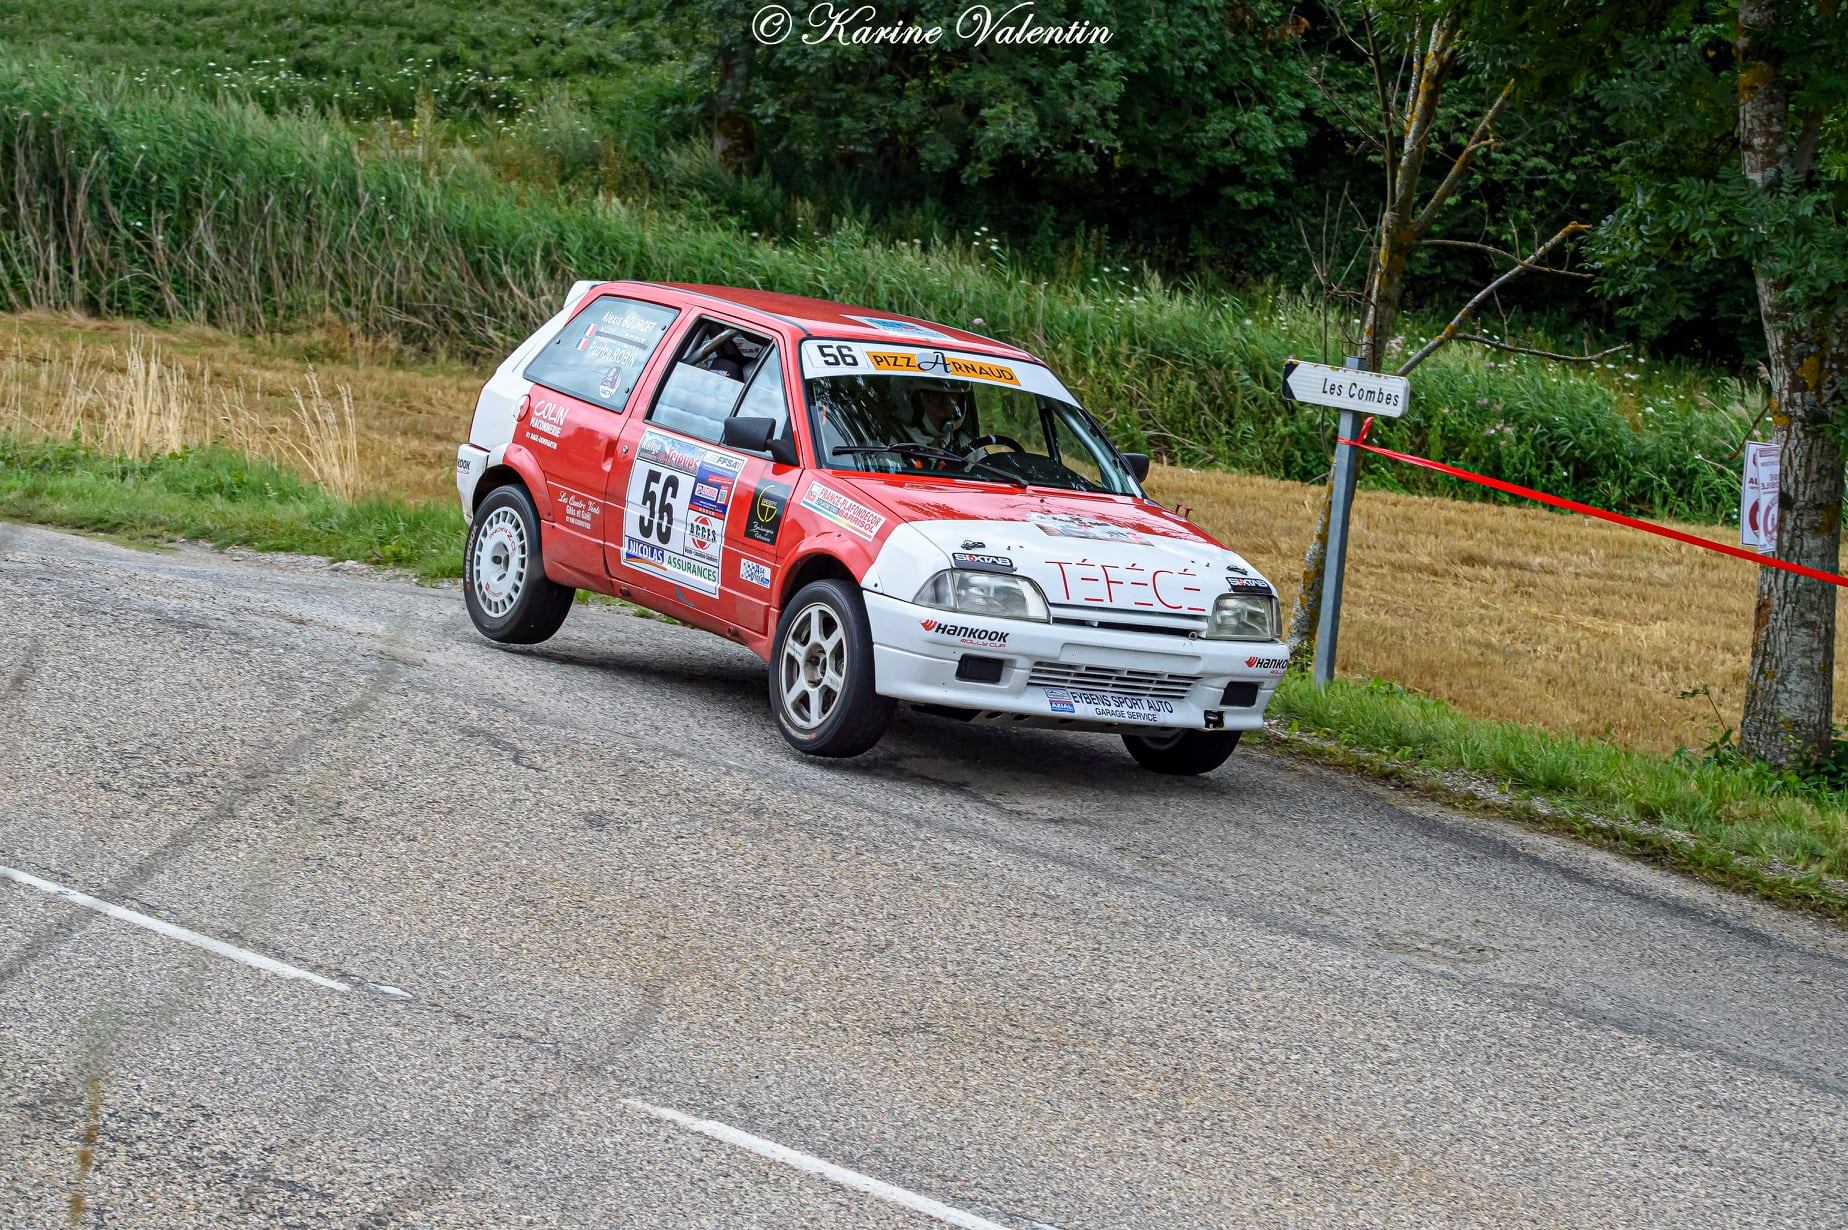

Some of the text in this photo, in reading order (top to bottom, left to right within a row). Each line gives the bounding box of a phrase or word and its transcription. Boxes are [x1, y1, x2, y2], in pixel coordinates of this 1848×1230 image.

[817, 344, 859, 367] 56
[1322, 377, 1400, 407] Les Combes
[534, 399, 570, 426] COLIN
[638, 468, 680, 545] 56
[628, 537, 664, 565] NICOLAS
[667, 555, 717, 582] ASSURANCES
[1070, 691, 1112, 707] EYBENS
[1111, 695, 1146, 711] SPORT
[1147, 699, 1174, 714] AUTO
[1095, 707, 1158, 722] GARAGE SERVICE
